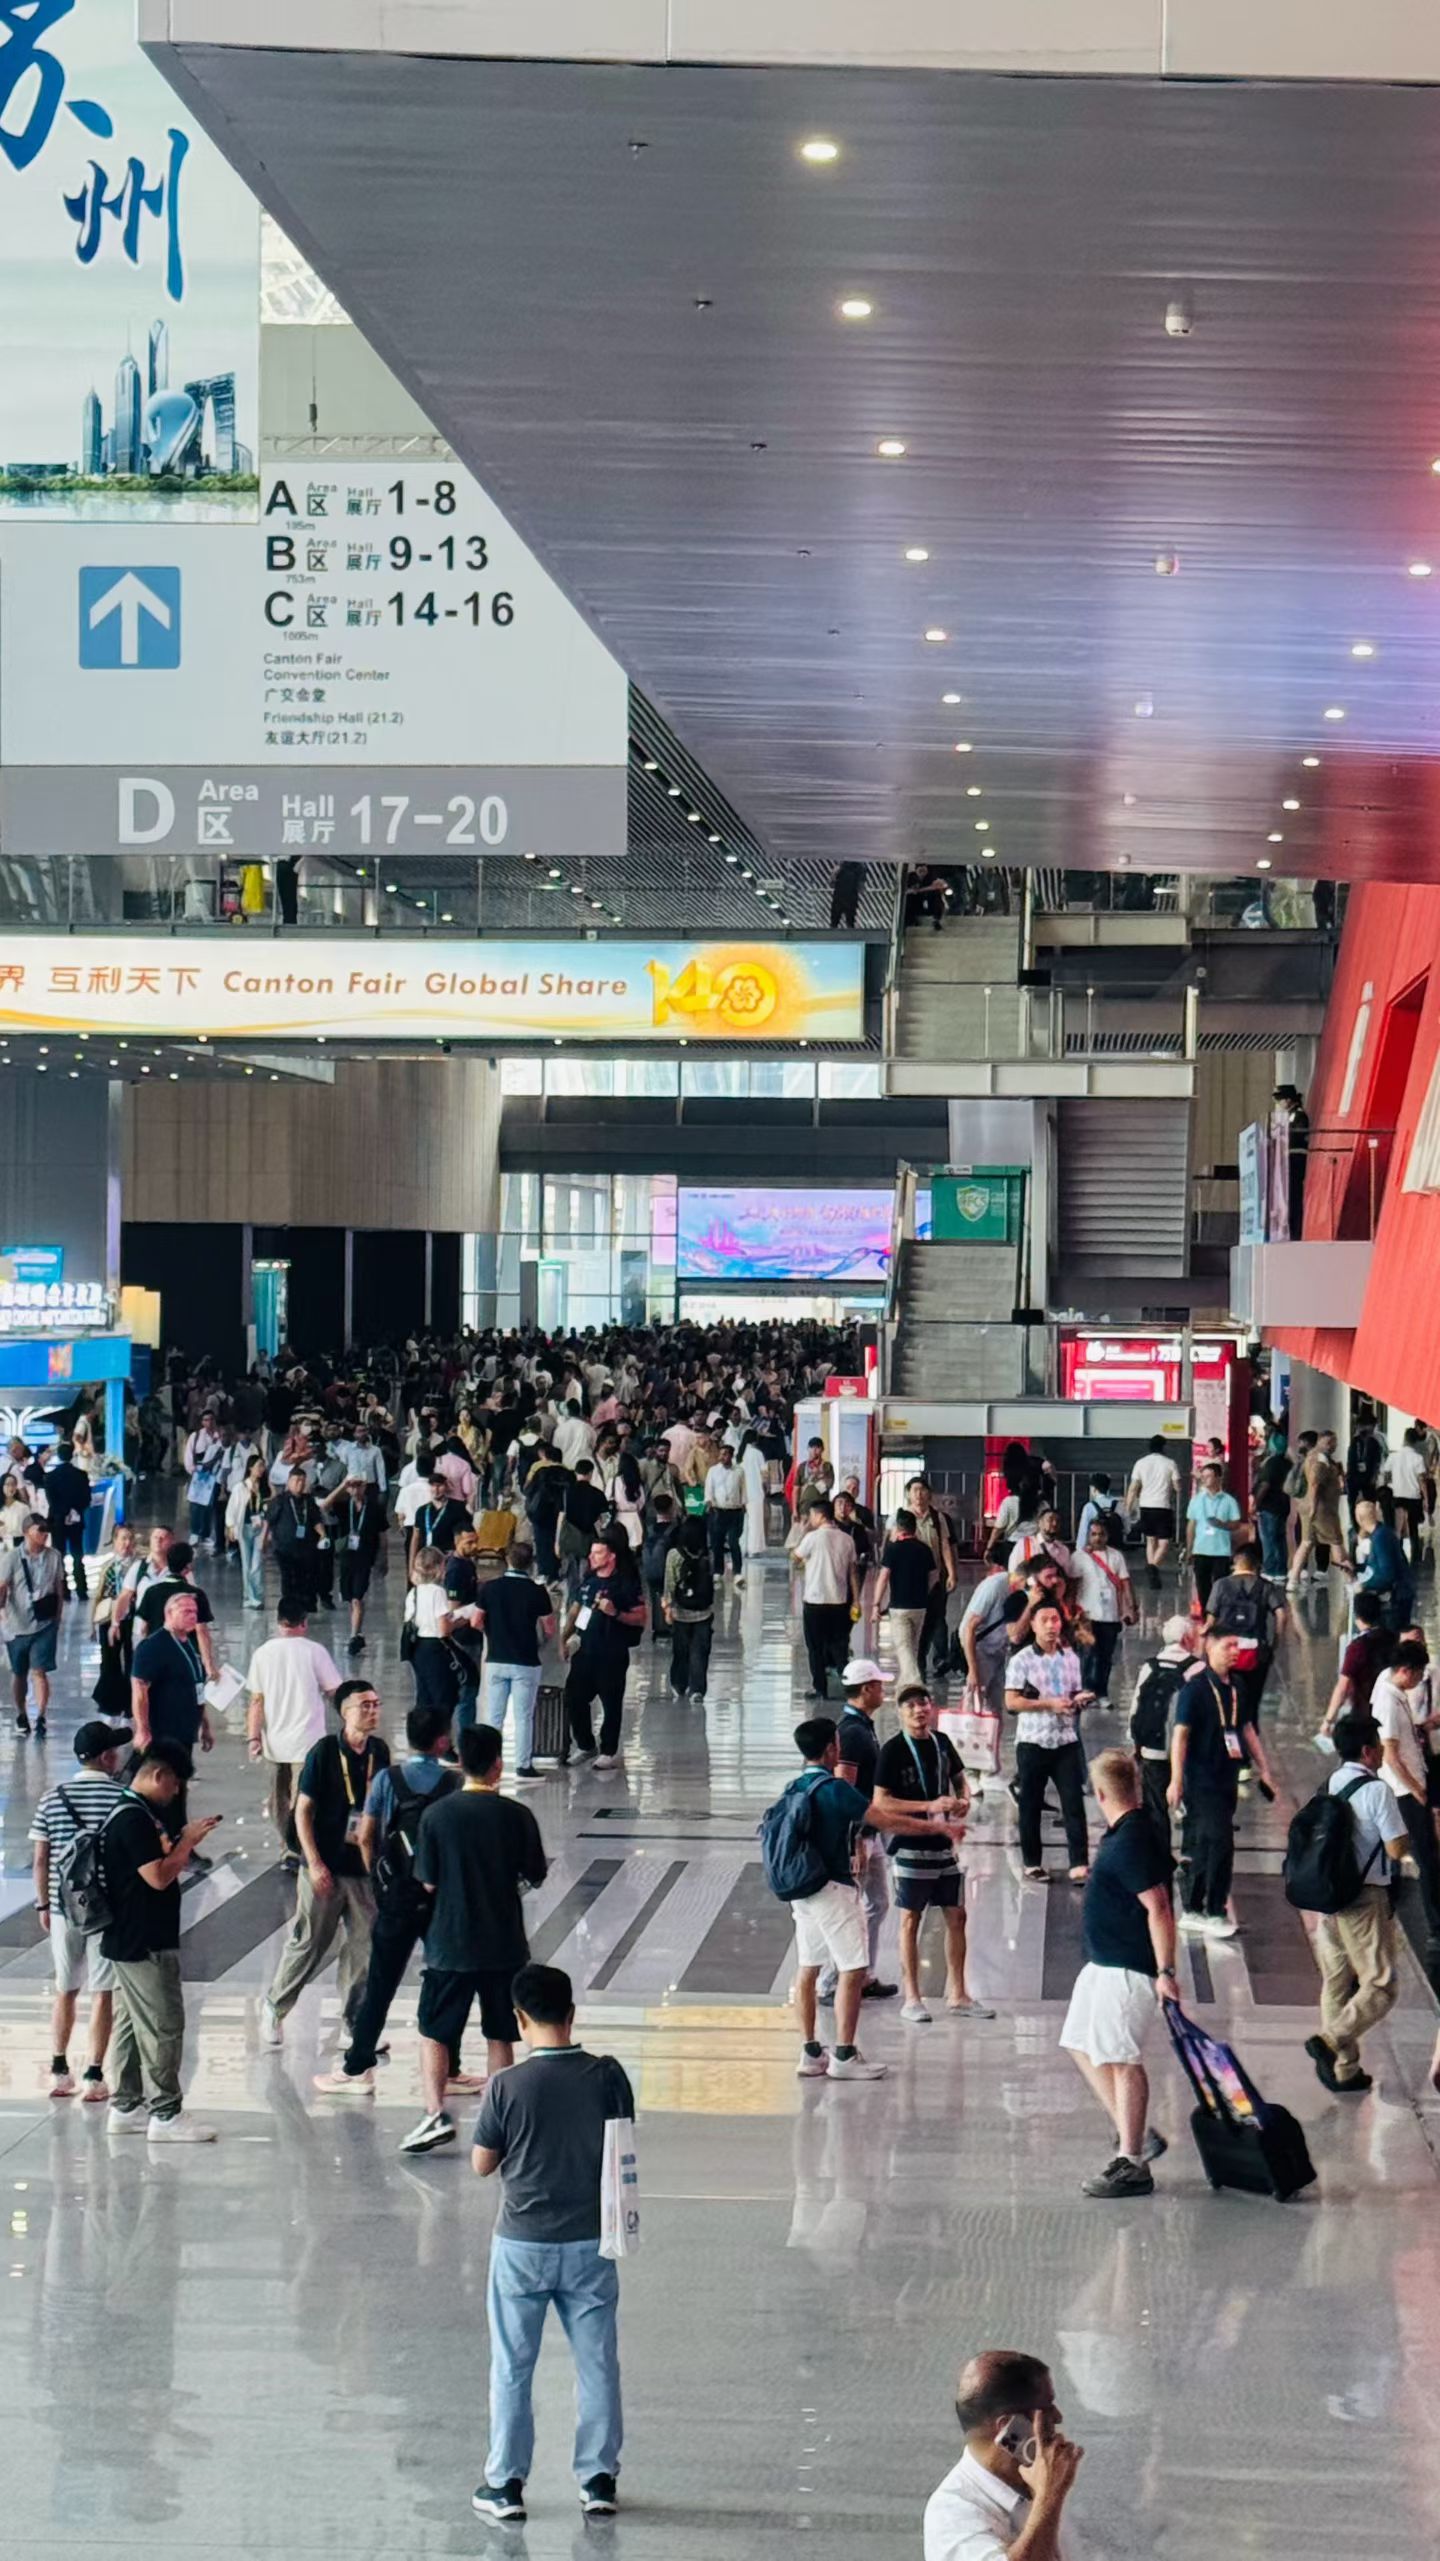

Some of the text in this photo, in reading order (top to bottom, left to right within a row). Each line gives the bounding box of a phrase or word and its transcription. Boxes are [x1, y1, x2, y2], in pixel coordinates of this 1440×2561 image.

[264, 480, 457, 516] A Area Hall 1-8
[307, 494, 382, 517] 区 展厅
[266, 536, 489, 571] B Area Hall 9-13
[307, 549, 382, 572] 区 展厅
[264, 591, 515, 627] C Area Hall 14-16
[307, 605, 382, 628] 区 展厅
[263, 653, 343, 665] Canton Fair
[263, 668, 390, 681] Convention Center
[263, 712, 404, 727] Friendship Hall (21.2)
[118, 777, 508, 845] D Area Hall 17-20
[197, 805, 335, 845] 区 展厅
[47, 965, 201, 995] 互利天下
[223, 970, 628, 996] Canton Fair Global Share
